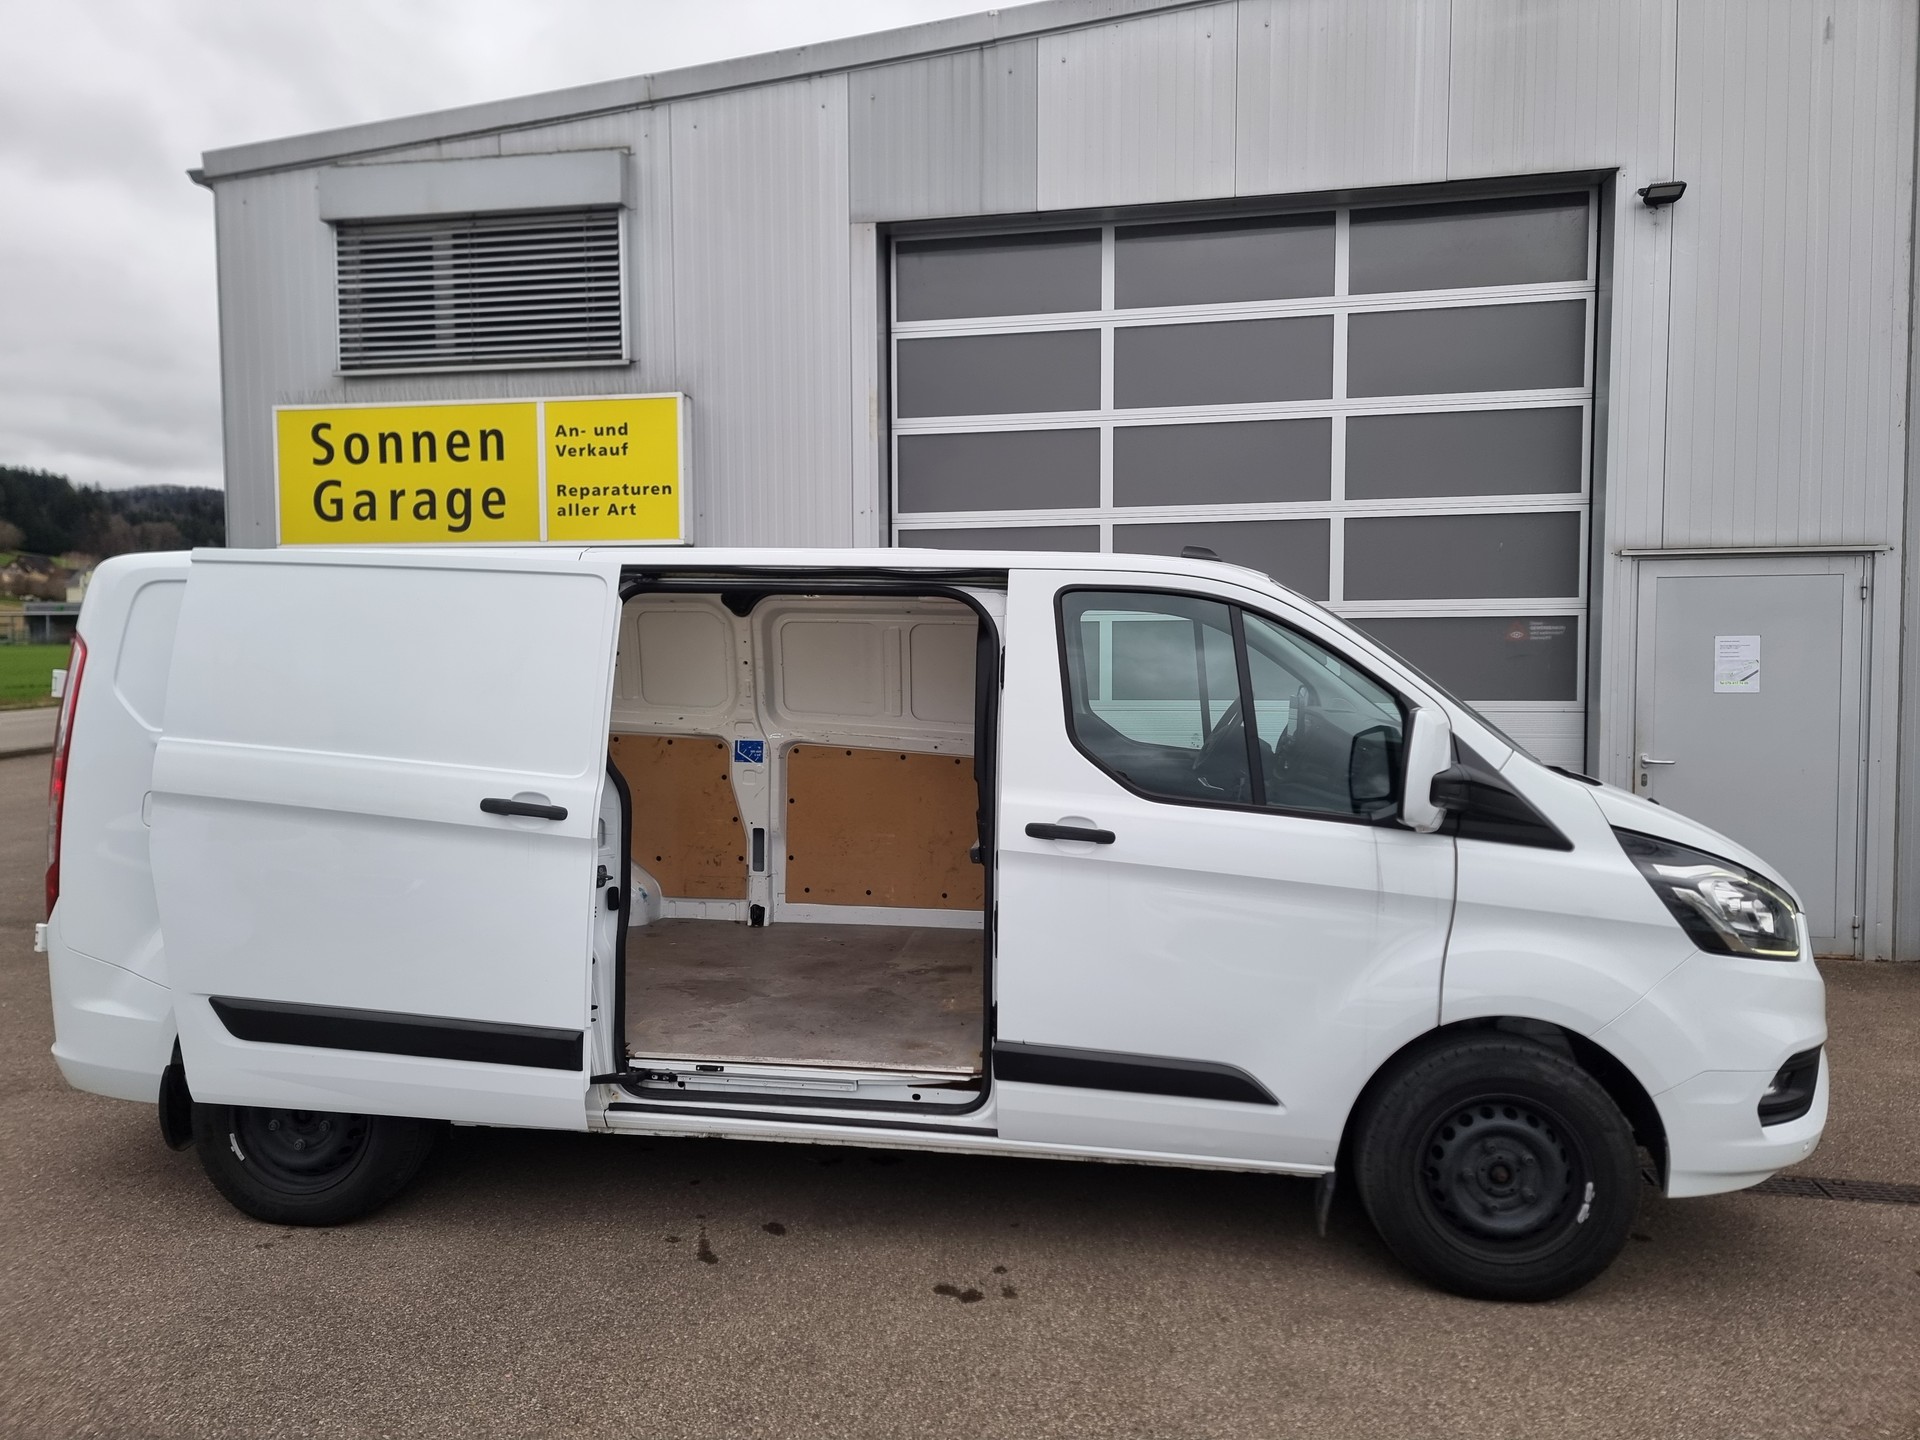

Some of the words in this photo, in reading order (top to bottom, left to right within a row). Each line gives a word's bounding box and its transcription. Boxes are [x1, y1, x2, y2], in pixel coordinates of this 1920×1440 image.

[556, 424, 586, 437] An-
[594, 422, 629, 437] und
[311, 422, 505, 466] Sonnen
[556, 442, 629, 457] Verkauf
[556, 483, 672, 499] Reparaturen
[313, 480, 506, 532] Garage
[557, 503, 600, 517] aller
[607, 503, 637, 517] Art
